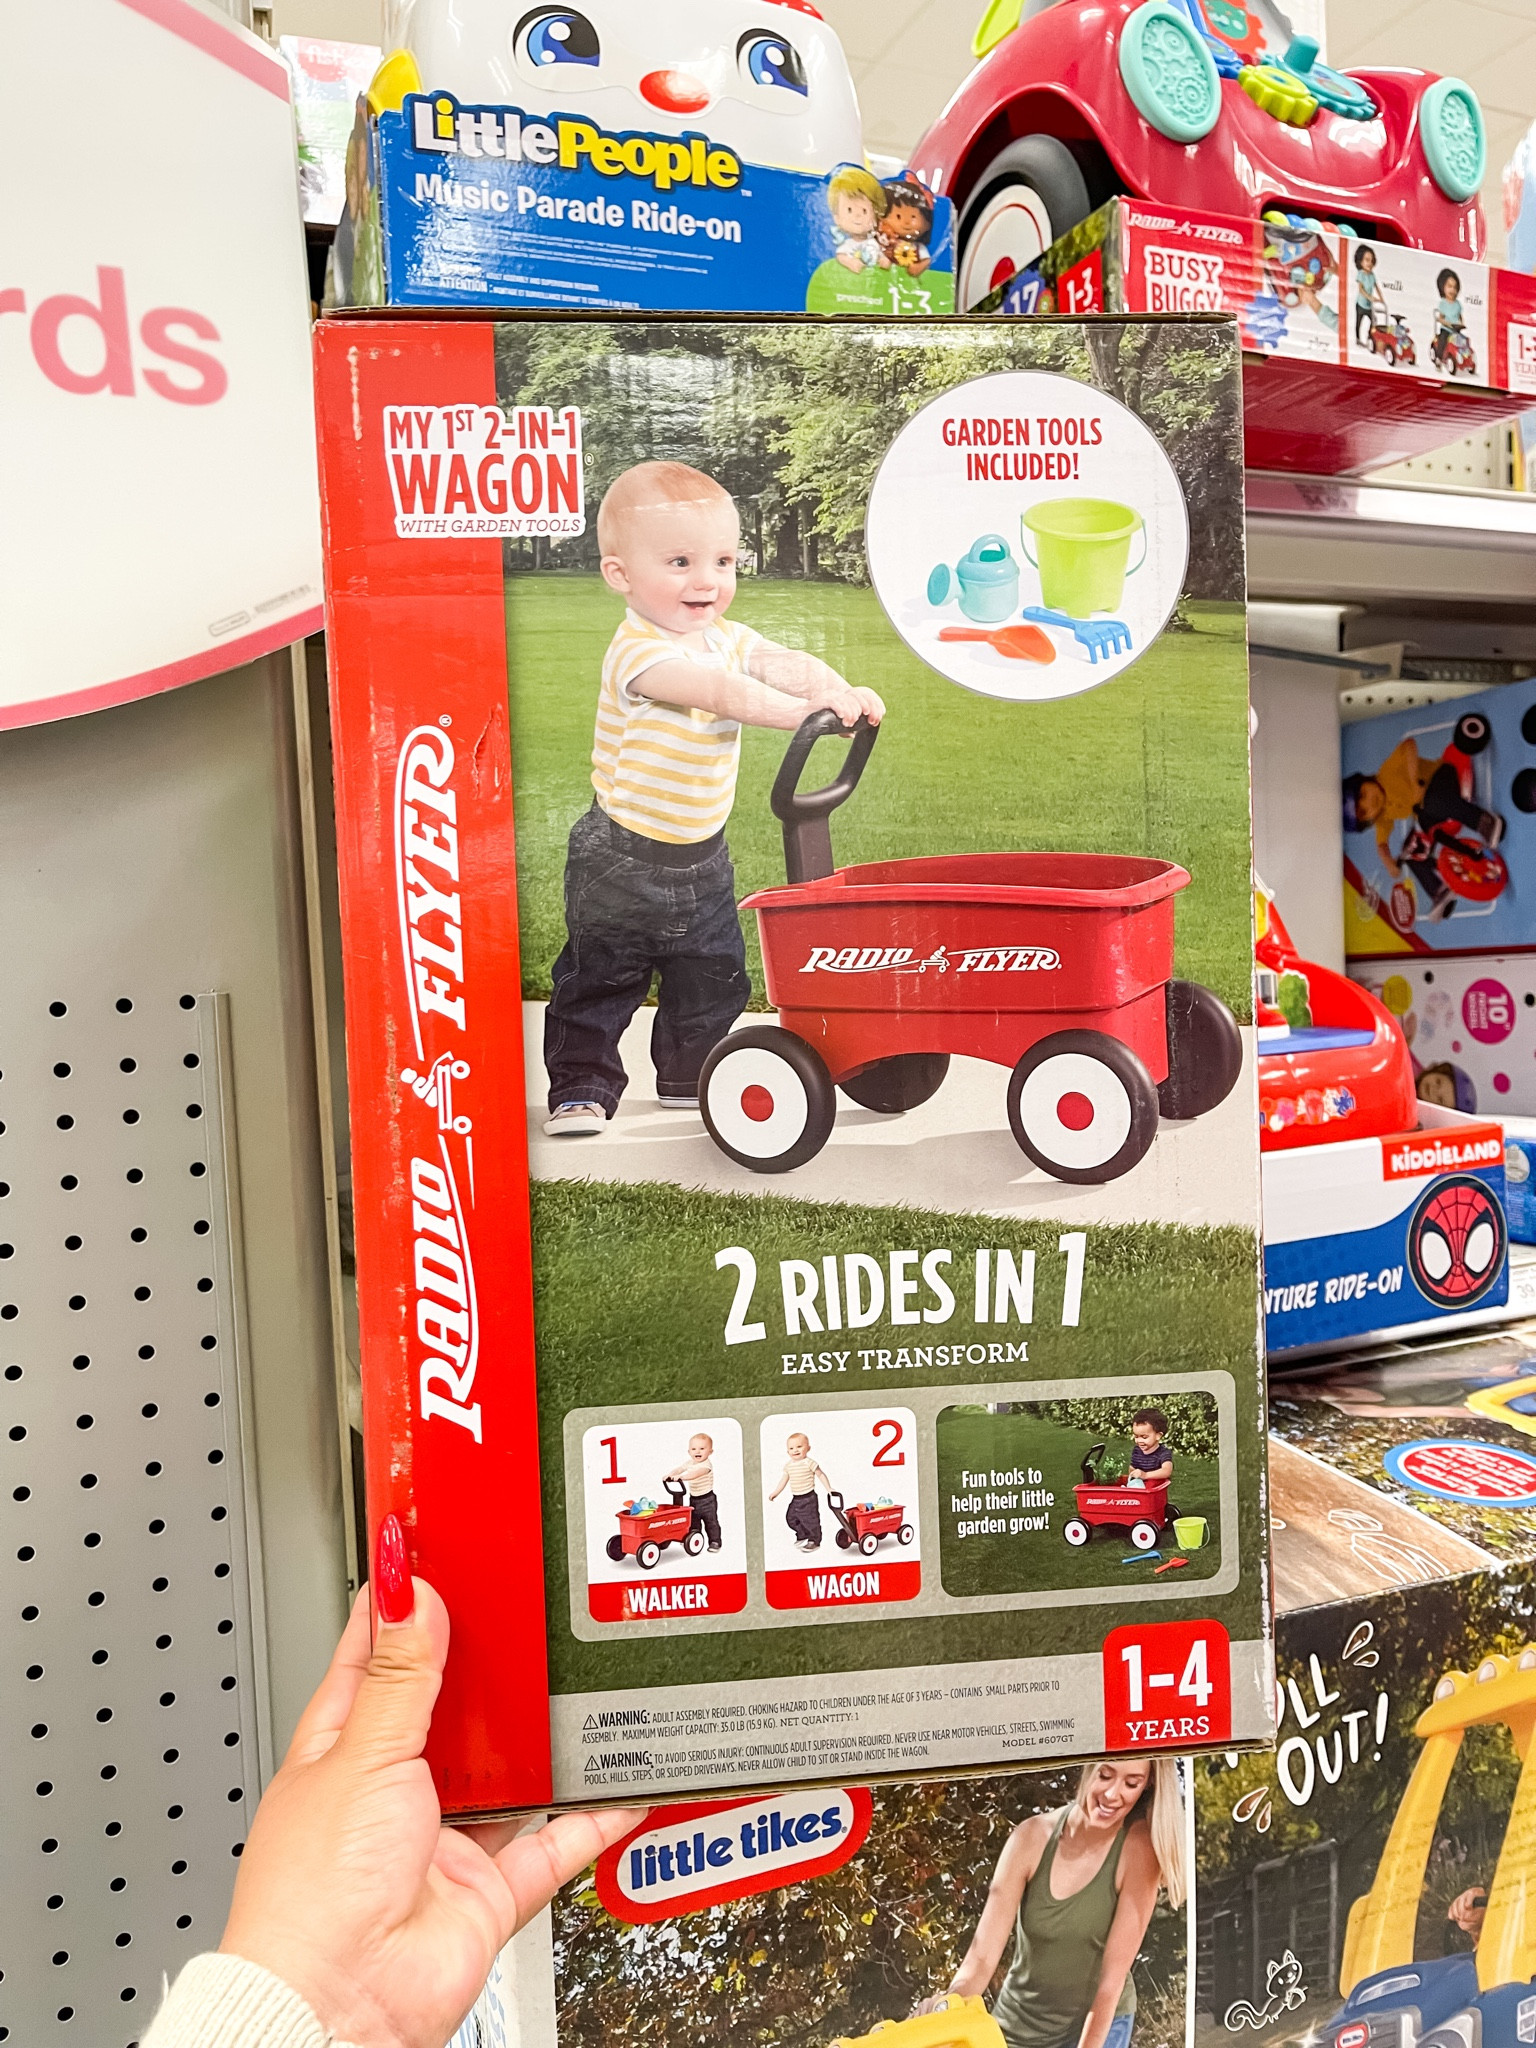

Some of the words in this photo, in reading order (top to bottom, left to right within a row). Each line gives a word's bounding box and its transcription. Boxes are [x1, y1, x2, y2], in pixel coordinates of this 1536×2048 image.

[415, 173, 509, 212] Music
[517, 186, 624, 228] Parade
[631, 200, 742, 243] Ride-on
[1150, 252, 1219, 283] BUSY
[1067, 267, 1093, 313] 1-3
[1153, 282, 1220, 312] BUGGY
[390, 411, 433, 449] MY
[443, 410, 474, 449] 1ST
[484, 411, 576, 449] 2-IN-1
[942, 418, 1029, 446] GARDEN
[1036, 418, 1103, 446] TOOLS
[392, 453, 579, 514] WAGON
[967, 453, 1079, 481] INCLUDED!
[401, 520, 448, 533] WITH
[451, 519, 521, 533] GARDEN
[525, 519, 581, 532] TOOLS
[394, 725, 466, 1040] FLYER
[799, 947, 916, 973] RADIO
[950, 946, 1060, 972] FLYER
[410, 1140, 483, 1445] RADIO
[714, 1246, 767, 1345] 2
[779, 1248, 956, 1336] RIDES
[974, 1248, 1036, 1324] IN
[1058, 1232, 1087, 1326] 1
[1325, 1266, 1403, 1304] RIDE-ON
[781, 1351, 849, 1375] EASY
[857, 1342, 1029, 1371] TRANSFORM
[600, 1436, 627, 1484] 1
[872, 1420, 905, 1467] 2
[962, 1470, 987, 1488] Fun
[990, 1467, 1025, 1487] tools
[1028, 1467, 1042, 1484] to
[952, 1494, 982, 1514] help
[985, 1491, 1018, 1510] their
[1022, 1489, 1054, 1508] little
[958, 1516, 1006, 1538] garden
[1010, 1512, 1049, 1535] grow!
[628, 1583, 709, 1613] WALKER
[807, 1571, 880, 1600] WAGON
[1121, 1640, 1213, 1712] 1-4
[599, 1709, 650, 1727] WARNING:
[652, 1711, 674, 1723] ADULT
[676, 1709, 710, 1722] ASSEMBLY
[712, 1706, 747, 1719] REQUIRED.
[748, 1702, 778, 1715] CHOKING
[780, 1701, 807, 1713] HAZARD
[809, 1700, 818, 1710] TO
[820, 1697, 851, 1709] CHILDREN
[853, 1695, 876, 1707] UNDER
[878, 1694, 890, 1705] THE
[891, 1692, 905, 1703] AGE
[906, 1692, 914, 1702] OF
[916, 1691, 921, 1702] 3
[922, 1689, 942, 1701] YEARS
[950, 1686, 982, 1699] CONTAINS
[986, 1684, 1007, 1696] SMALL
[1008, 1682, 1029, 1694] PARTS
[1030, 1681, 1050, 1693] PRIOR
[1051, 1680, 1060, 1691] TO
[582, 1731, 619, 1744] ASSEMBLY.
[622, 1727, 656, 1741] MAXIMUM
[657, 1725, 684, 1738] WEIGHT
[685, 1723, 720, 1736] CAPACITY:
[721, 1721, 735, 1733] 35.0
[736, 1720, 745, 1731] LB
[746, 1719, 762, 1732] (15.9
[763, 1718, 778, 1730] KG).
[780, 1717, 800, 1727] NET
[802, 1713, 854, 1726] QUANTITY:
[855, 1712, 859, 1721] 1
[600, 1751, 652, 1769] WARNING:
[655, 1753, 663, 1764] TO
[665, 1751, 686, 1764] AVOID
[688, 1749, 716, 1762] SERIOUS
[718, 1747, 744, 1759] INJURY:
[746, 1743, 788, 1757] CONTINUOUS
[790, 1741, 812, 1753] ADULT
[813, 1737, 857, 1751] SUPERVISION
[858, 1734, 894, 1747] REQUIRED.
[895, 1732, 916, 1743] NEVER
[918, 1730, 930, 1742] USE
[932, 1729, 950, 1741] NEAR
[952, 1727, 975, 1738] MOTOR
[976, 1724, 1008, 1737] VEHICLES,
[1010, 1721, 1038, 1734] STREETS,
[1039, 1718, 1075, 1731] SWIMMING
[1002, 1738, 1036, 1748] MODEL
[1038, 1734, 1075, 1745] #607GT
[1126, 1716, 1210, 1741] YEARS
[584, 1773, 609, 1785] POOLS,
[610, 1771, 630, 1783] HILLS,
[631, 1769, 653, 1781] STEPS,
[655, 1768, 665, 1779] OR
[667, 1765, 692, 1778] SLOPED
[694, 1762, 737, 1776] DRIVEWAYS.
[738, 1759, 760, 1772] NEVER
[762, 1757, 785, 1770] ALLOW
[787, 1756, 806, 1768] CHILD
[808, 1755, 817, 1766] TO
[818, 1754, 828, 1765] SIT
[830, 1753, 840, 1763] OR
[841, 1750, 863, 1763] STAND
[864, 1749, 886, 1760] INSIDE
[887, 1748, 900, 1759] THE
[901, 1746, 930, 1758] WAGON.
[1277, 1693, 1388, 1806] OUT!
[630, 1832, 733, 1890] little
[740, 1806, 841, 1859] tikes
